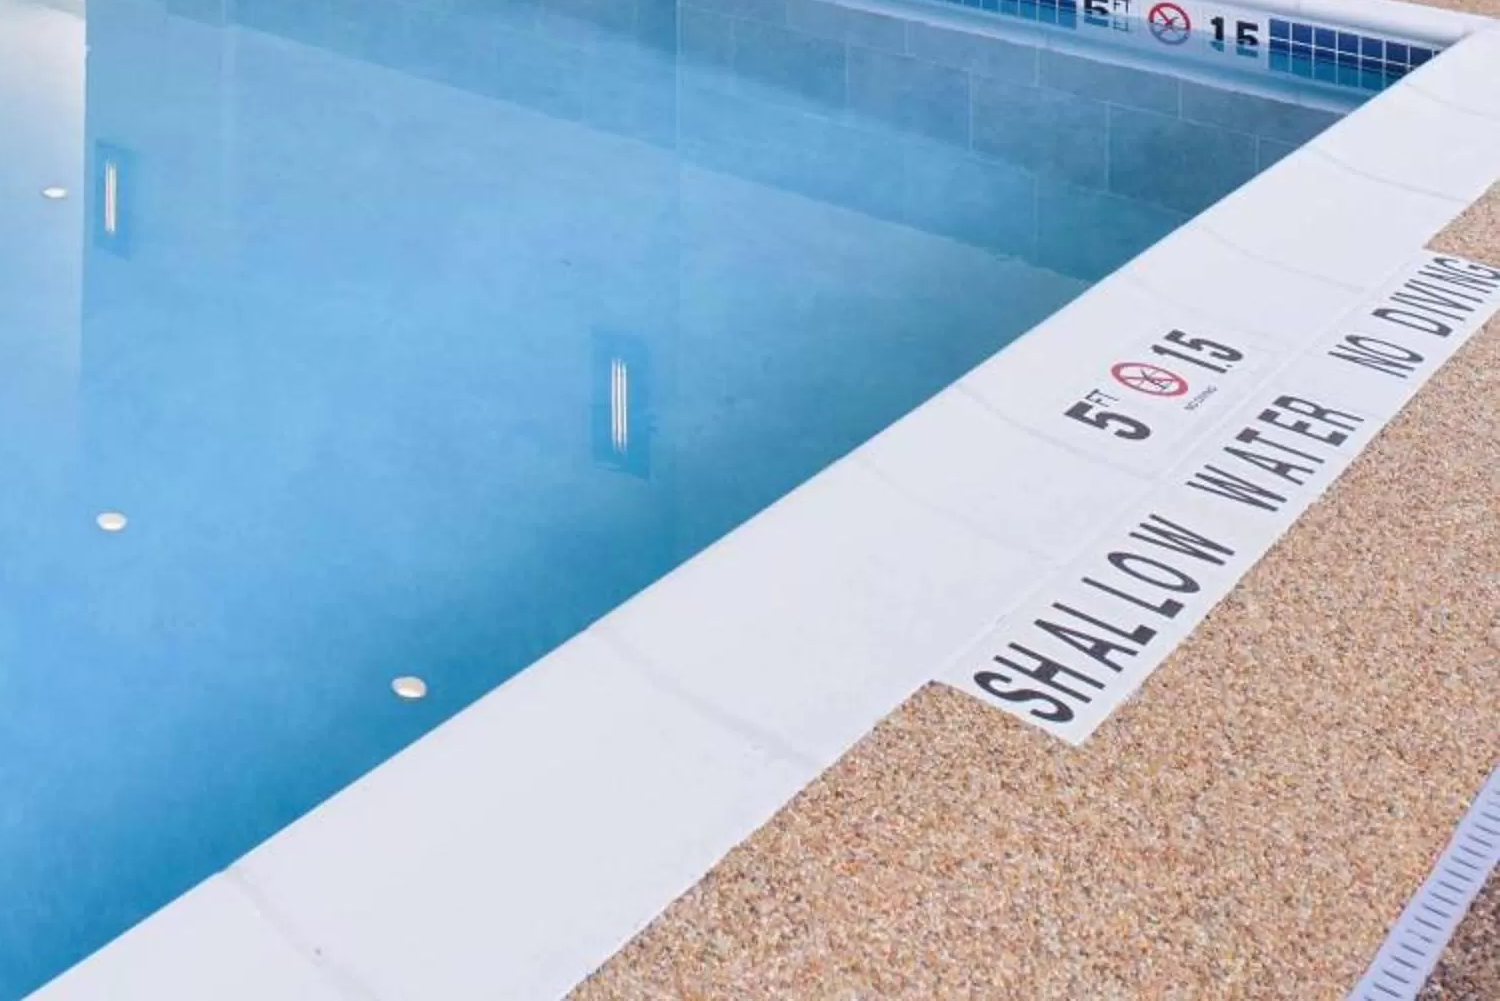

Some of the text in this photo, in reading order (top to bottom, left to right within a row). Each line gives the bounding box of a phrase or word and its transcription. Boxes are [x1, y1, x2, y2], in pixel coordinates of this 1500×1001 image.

[973, 257, 1500, 723] SHALLOW WATER NO DIVING
[1064, 388, 1152, 440] 5 FT
